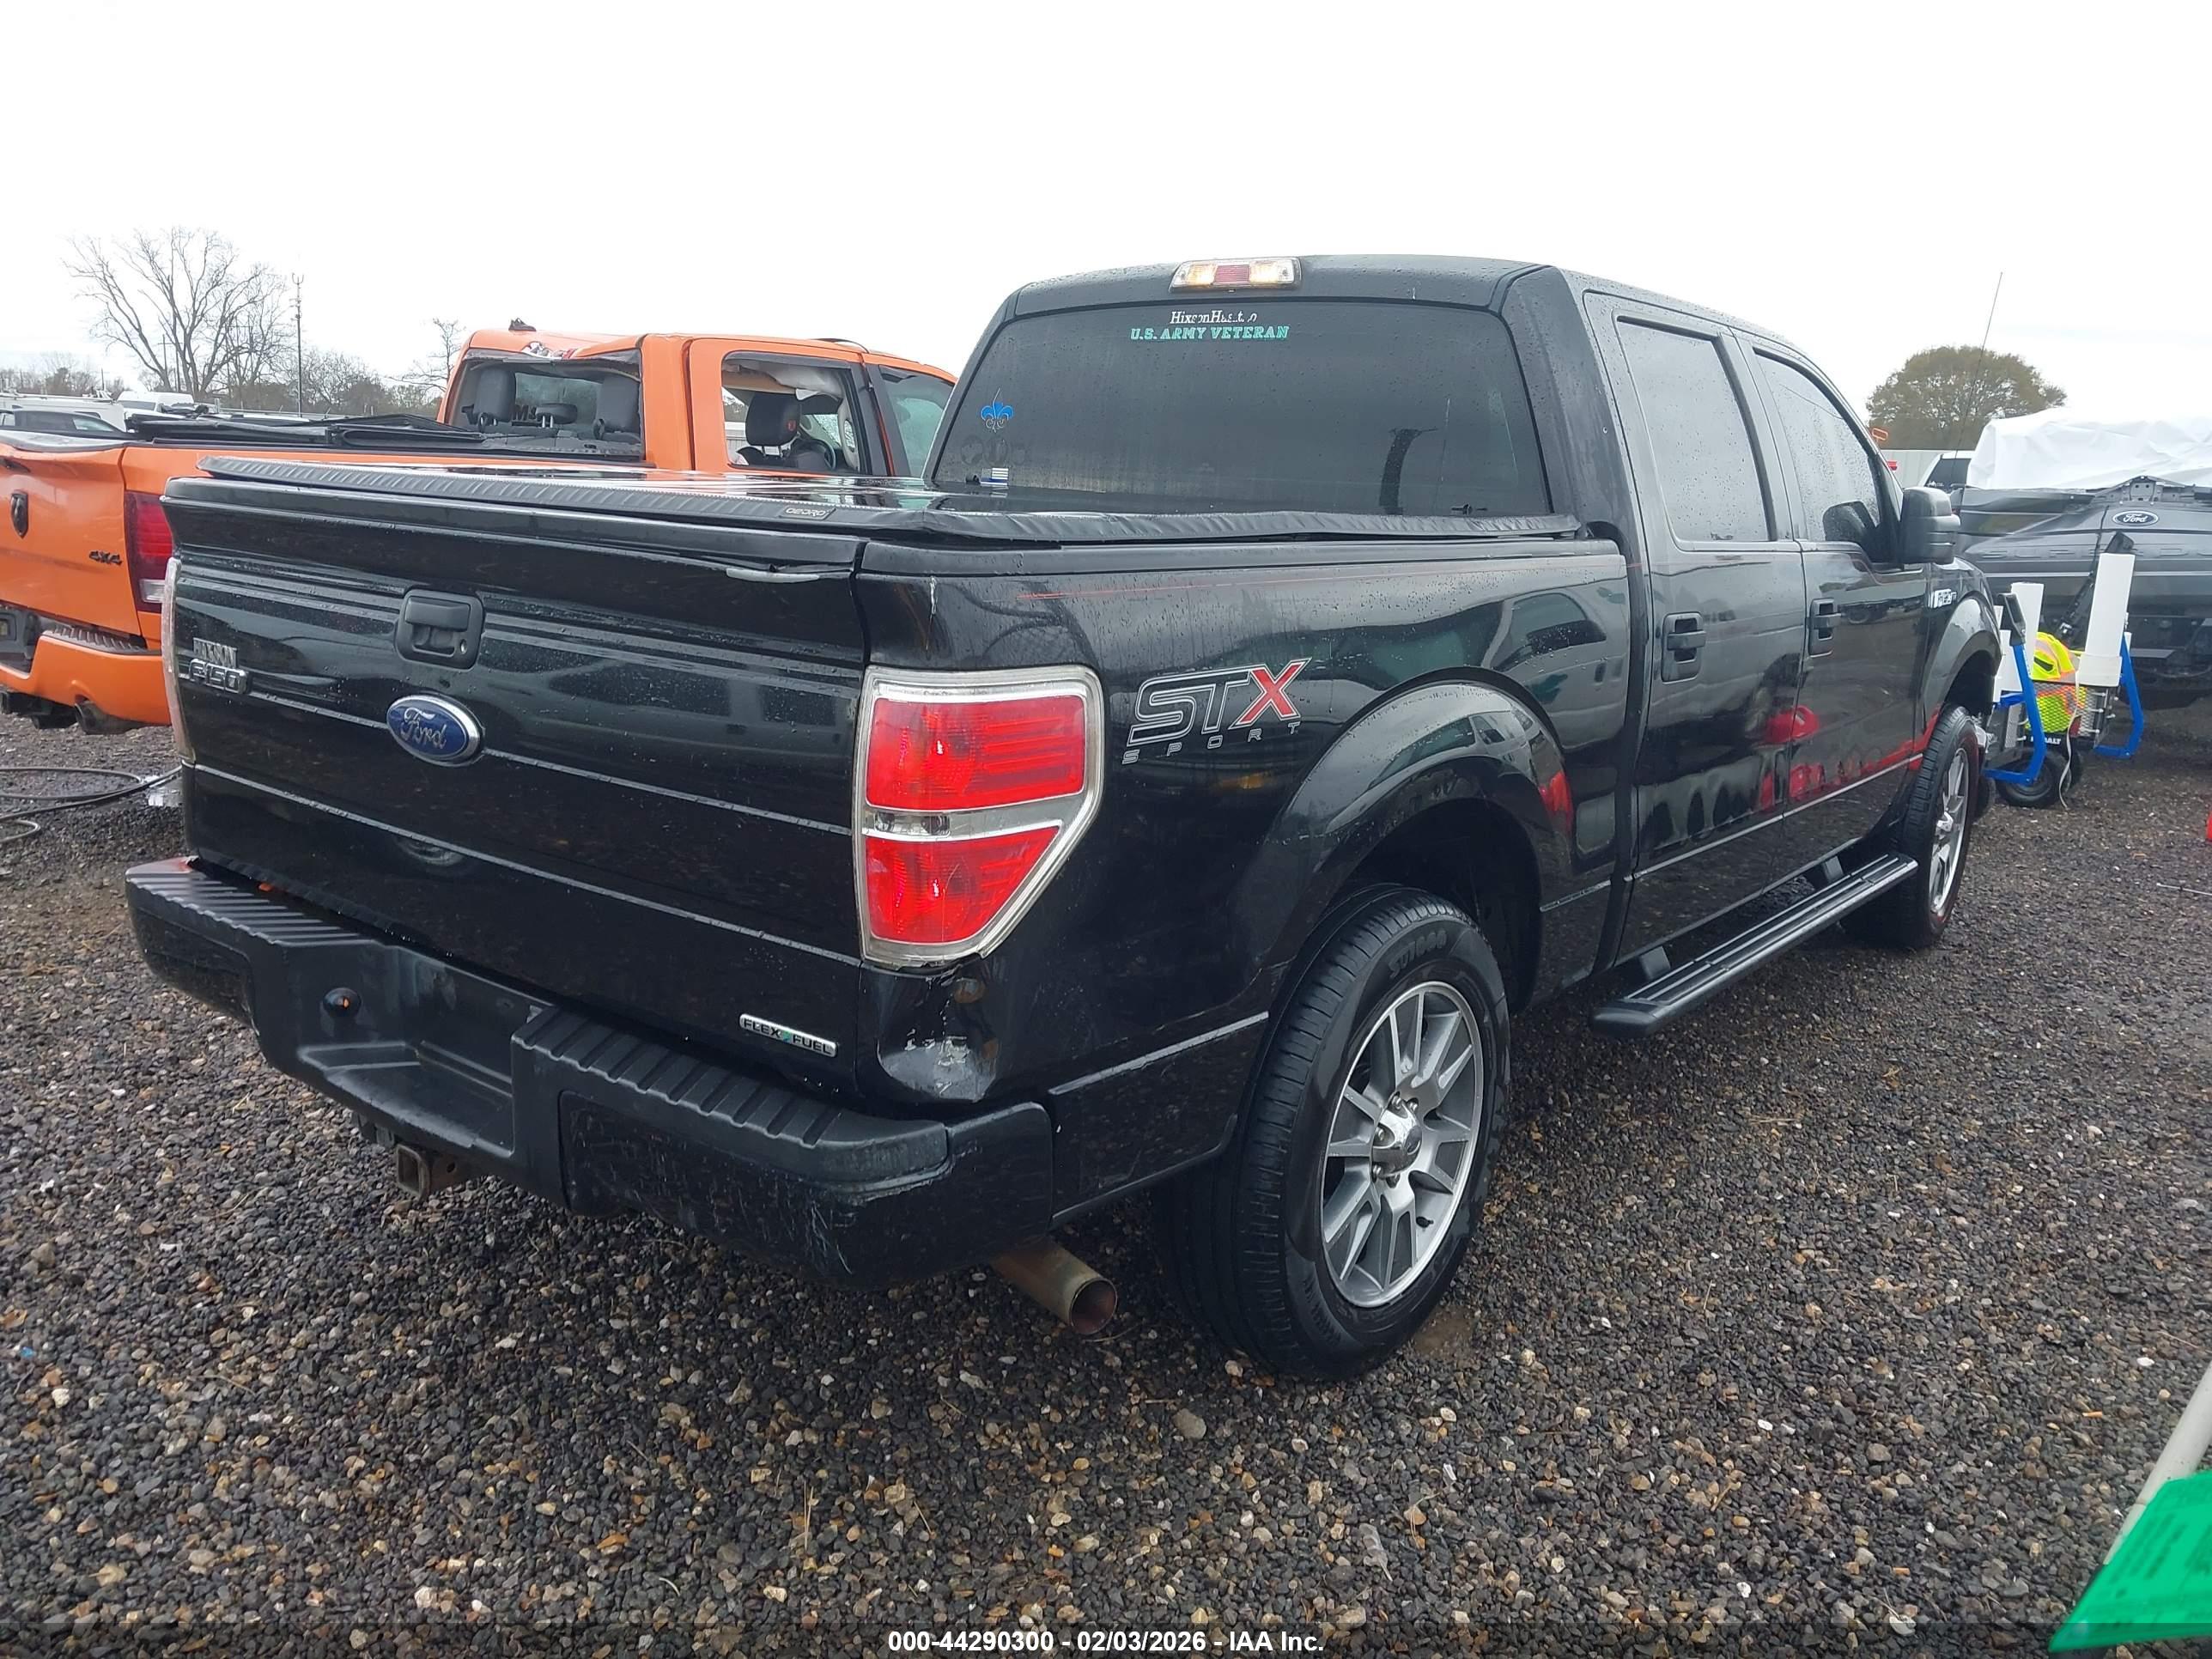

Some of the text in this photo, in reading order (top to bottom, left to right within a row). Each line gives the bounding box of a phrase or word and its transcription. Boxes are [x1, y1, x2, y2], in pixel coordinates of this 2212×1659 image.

[1130, 325, 1290, 340] U.S. ARMY VETERAN
[2123, 514, 2148, 523] Ford
[1126, 657, 1313, 747] STX
[400, 707, 447, 750] Ford
[1121, 720, 1301, 765] SPORT
[743, 1018, 834, 1055] FLEX FUEL
